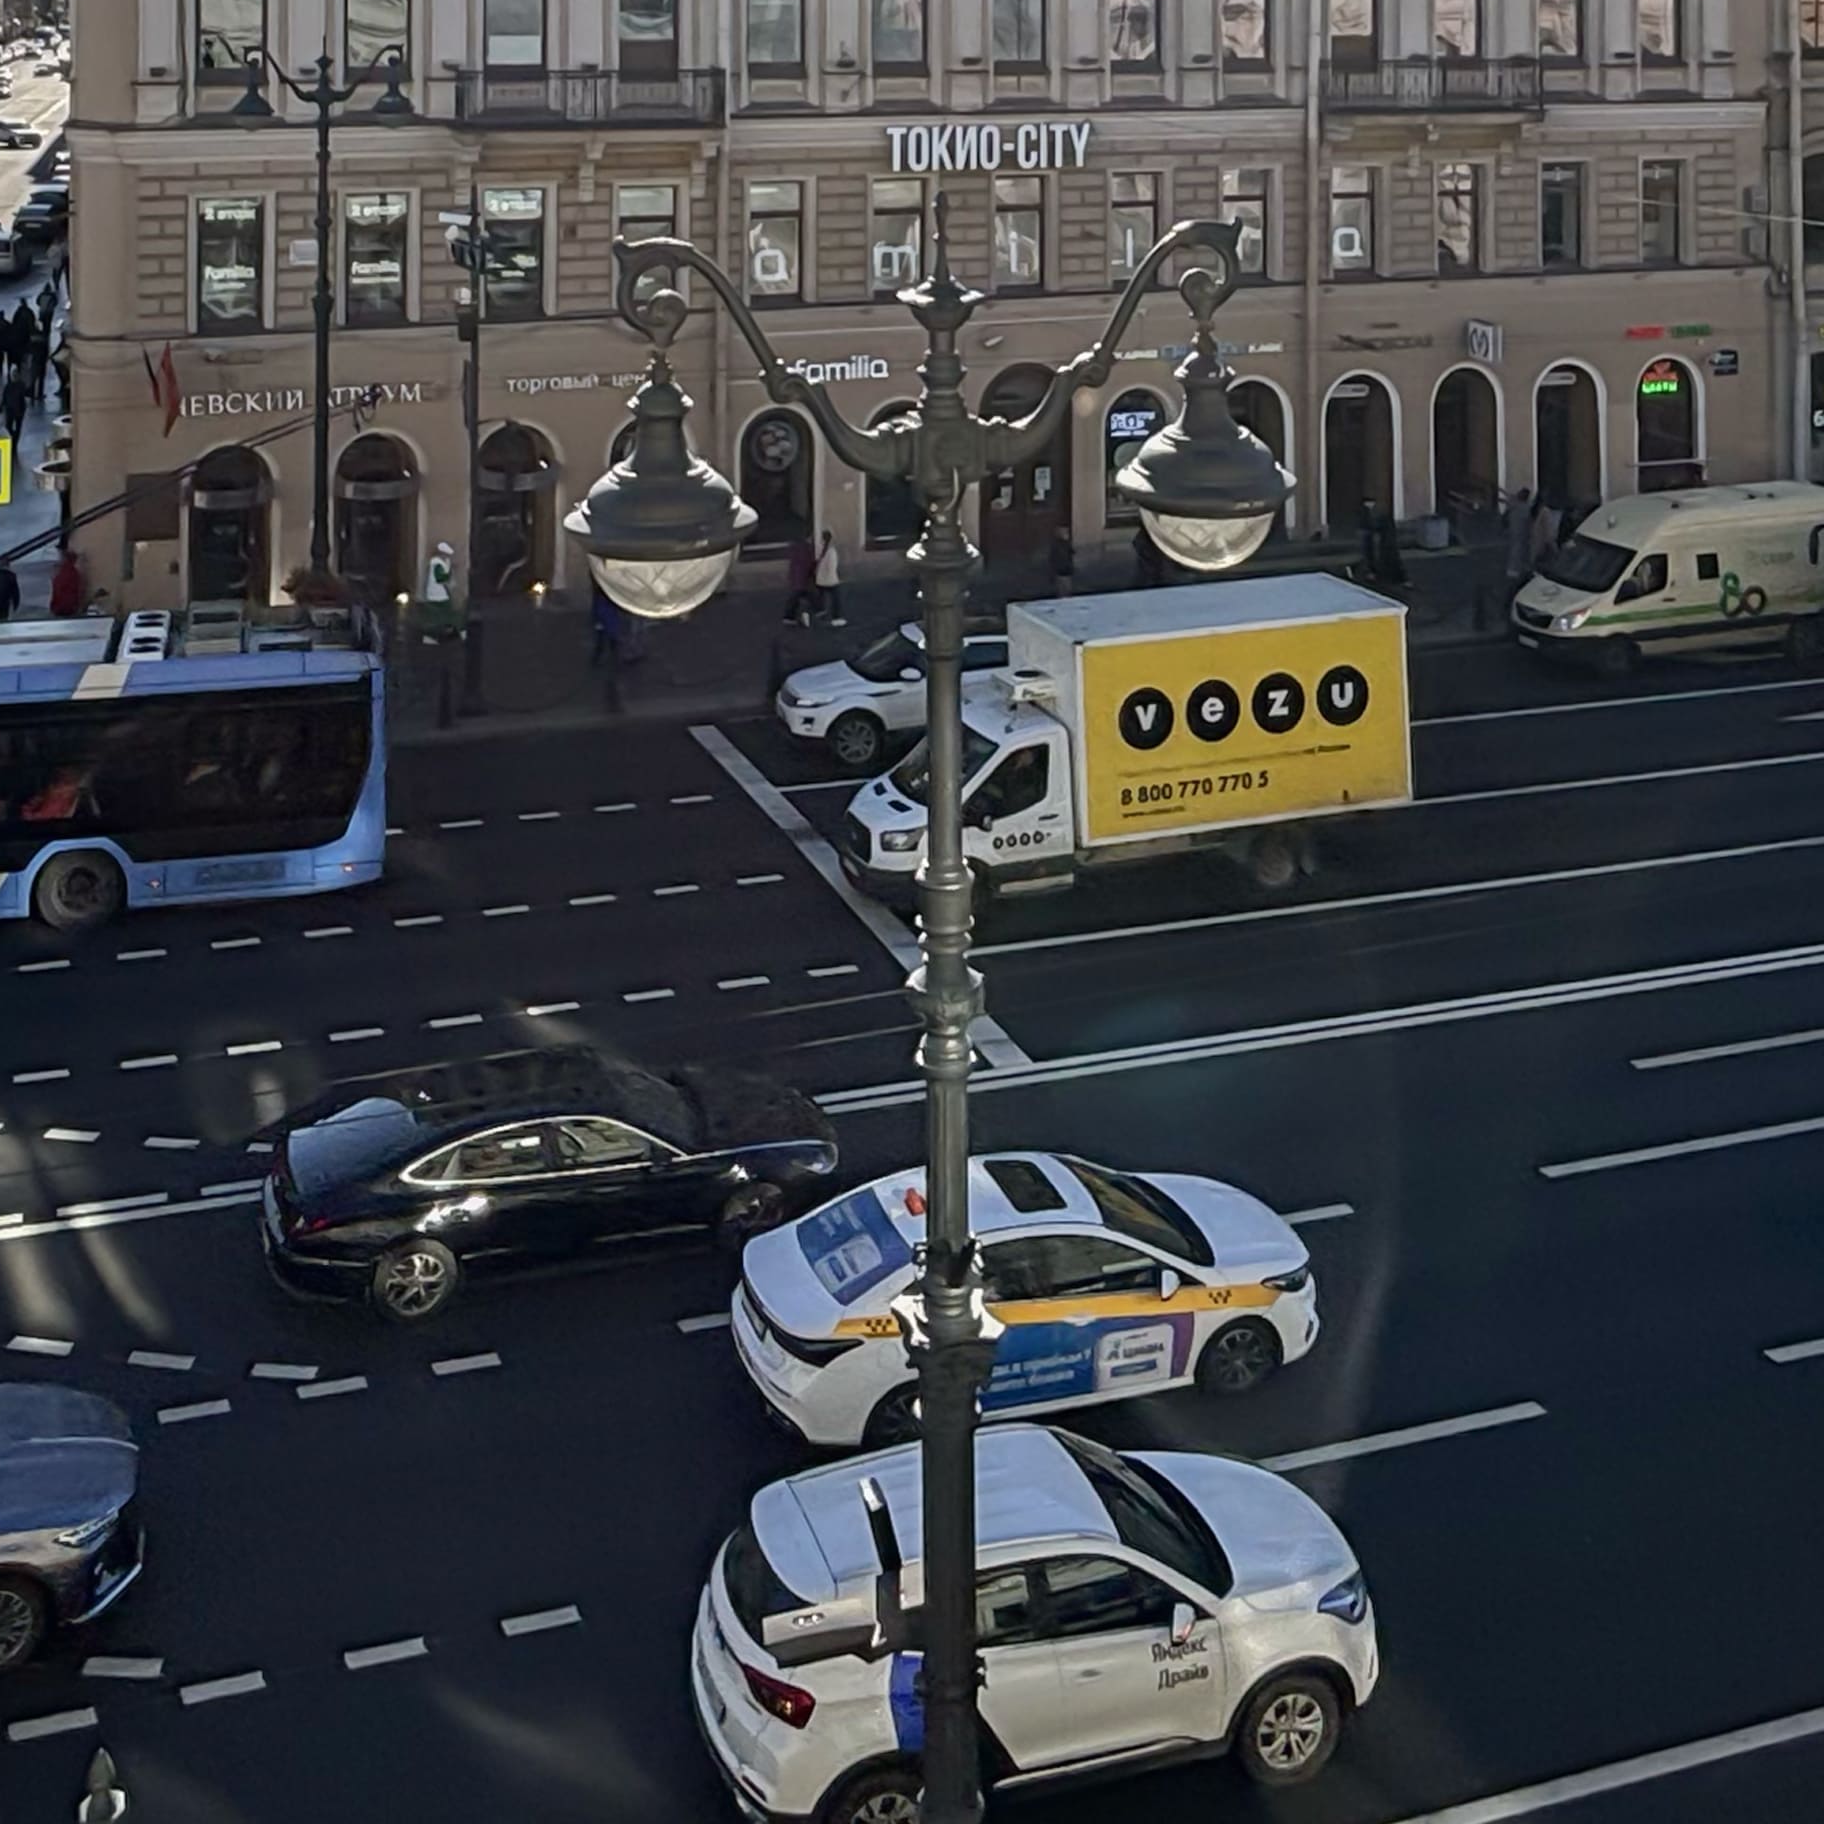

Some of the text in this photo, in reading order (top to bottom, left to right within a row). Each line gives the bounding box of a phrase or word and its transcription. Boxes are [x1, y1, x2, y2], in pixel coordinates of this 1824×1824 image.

[886, 121, 1091, 172] ТОКИО-CITY
[794, 354, 889, 385] familia
[1131, 678, 1358, 734] vezu
[1120, 769, 1270, 806] 8 800 770 770 5
